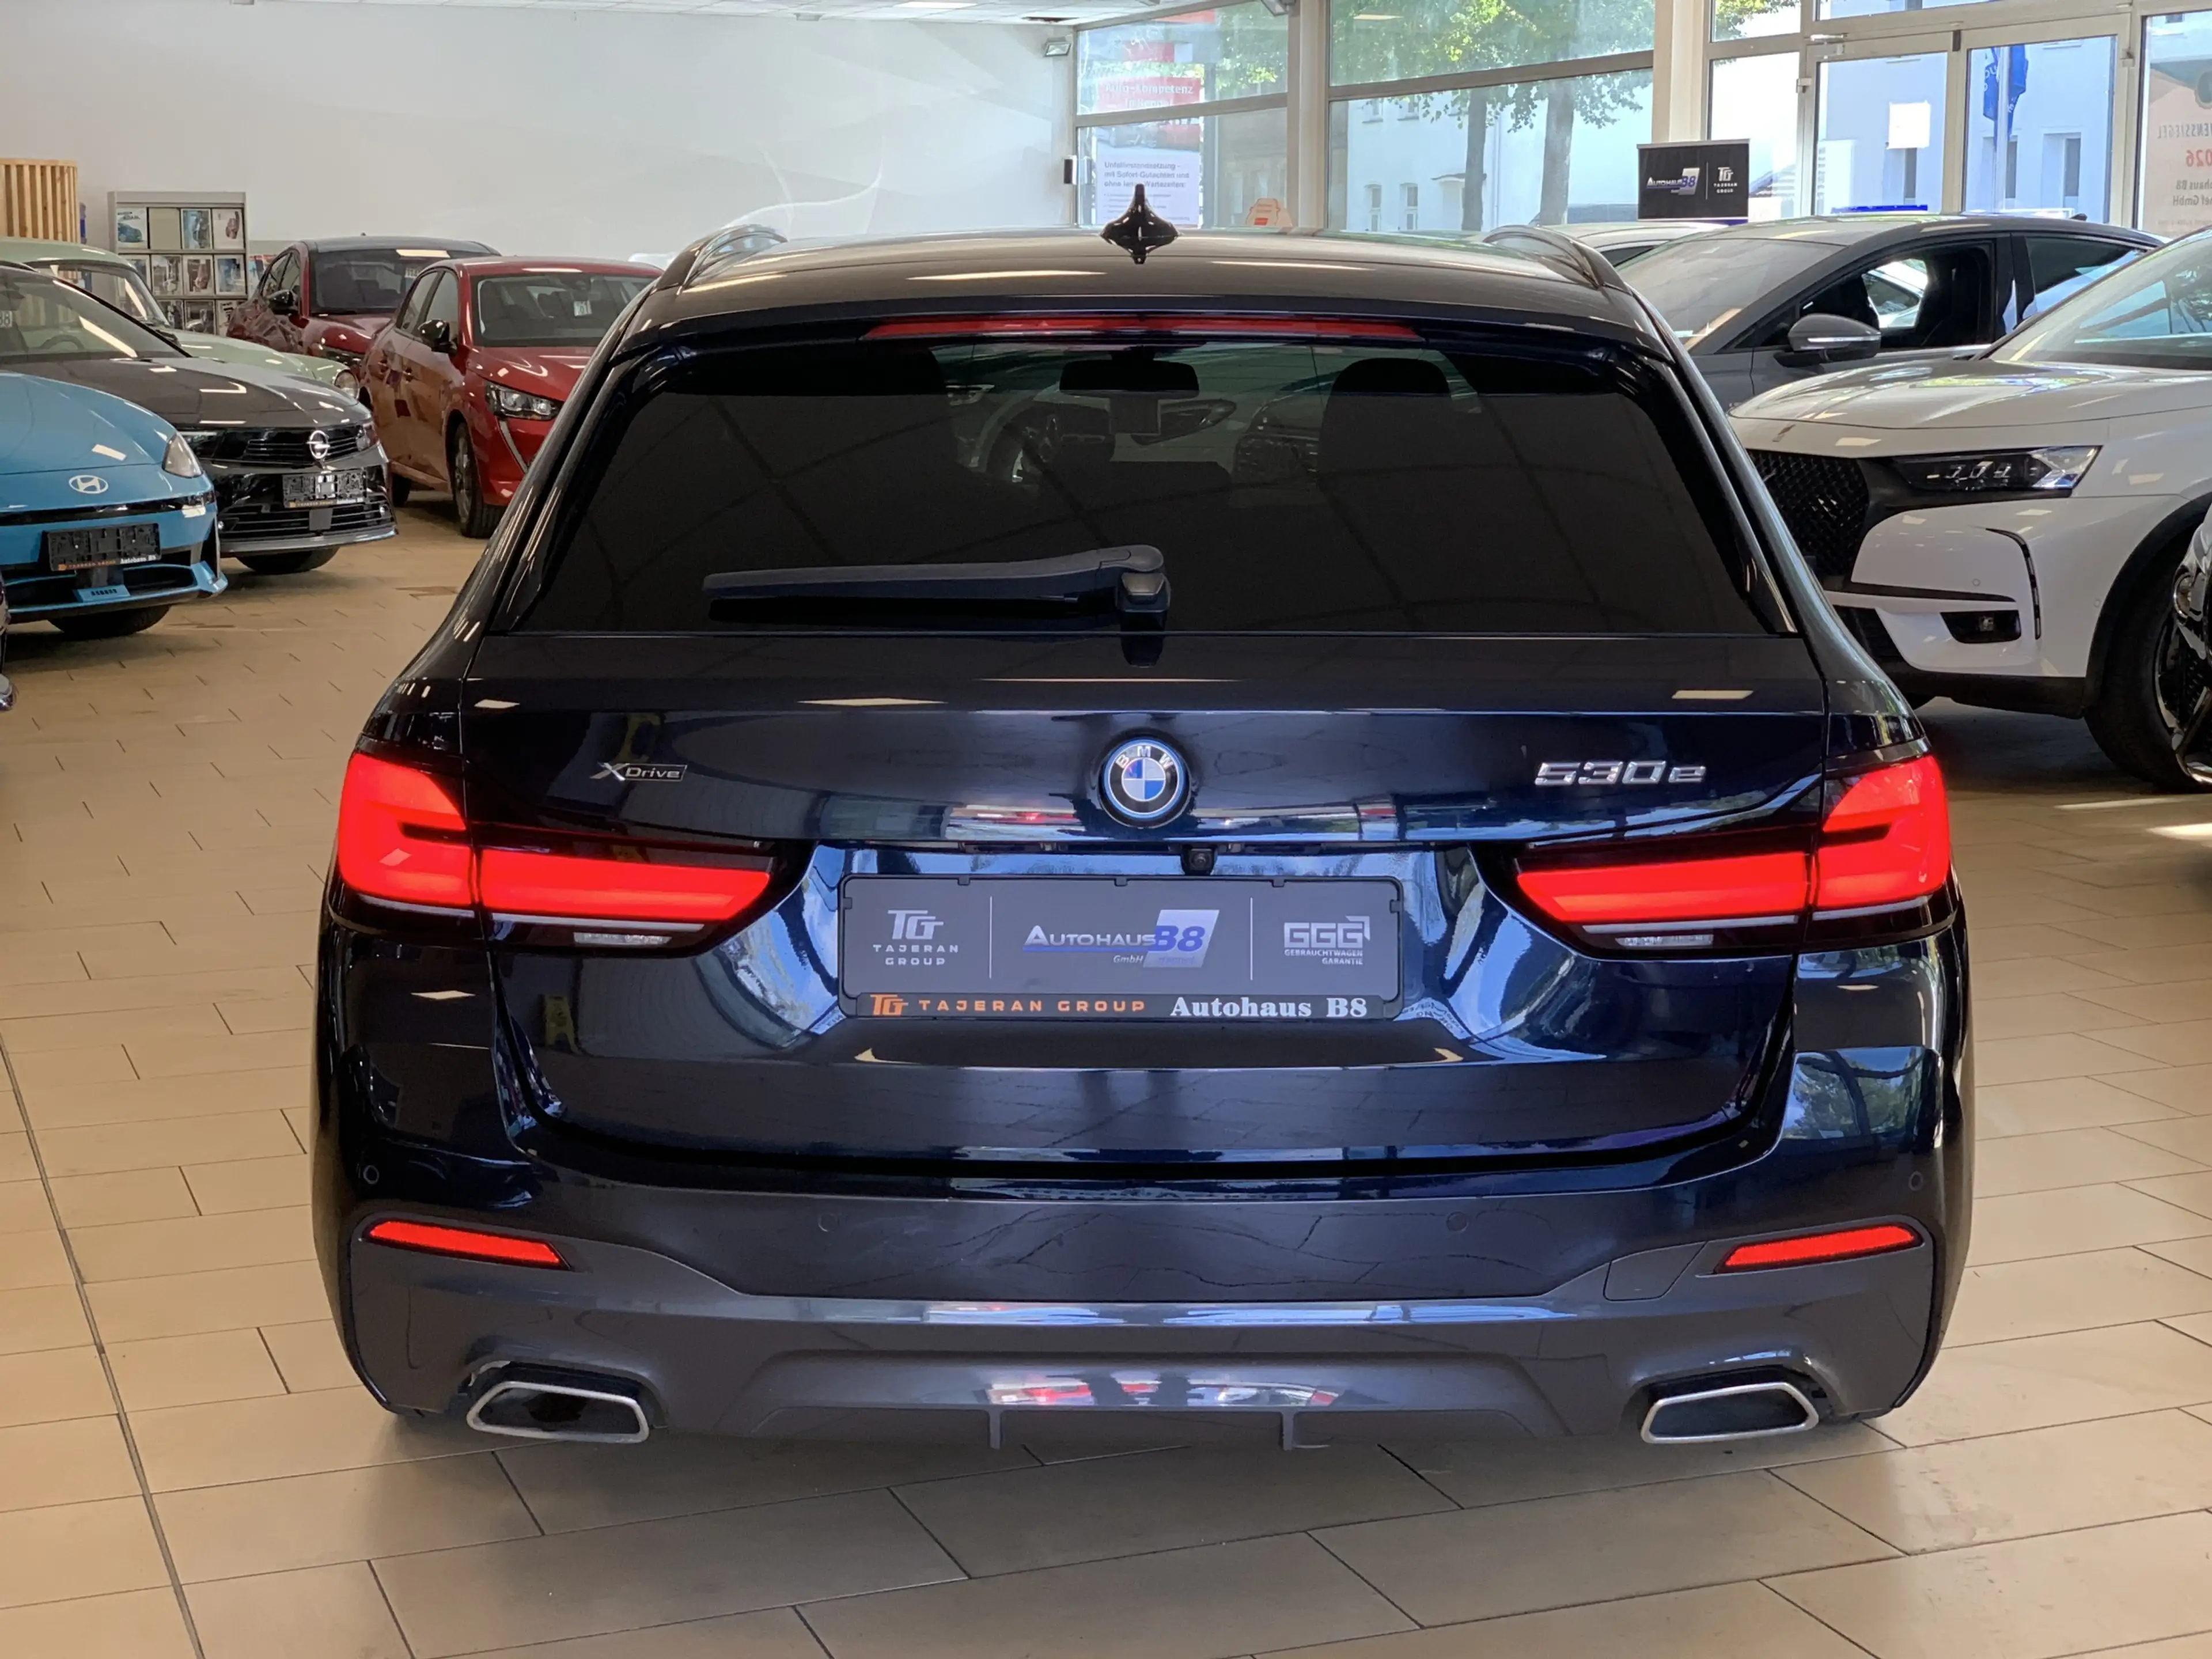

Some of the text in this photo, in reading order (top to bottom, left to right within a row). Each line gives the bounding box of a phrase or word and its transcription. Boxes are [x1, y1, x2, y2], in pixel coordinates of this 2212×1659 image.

[1115, 745, 1174, 769] BMW
[1535, 760, 1706, 785] 530e
[888, 910, 944, 940] TG
[1284, 922, 1363, 948] GGG
[873, 945, 958, 953] TAJERAN
[1113, 955, 1143, 964] GmbH
[1284, 949, 1363, 957] GEBRAUCHTWAGEN
[885, 957, 945, 965] GROUP
[870, 994, 1367, 1017] TG TAJERAN GROUP Autohaus B8
